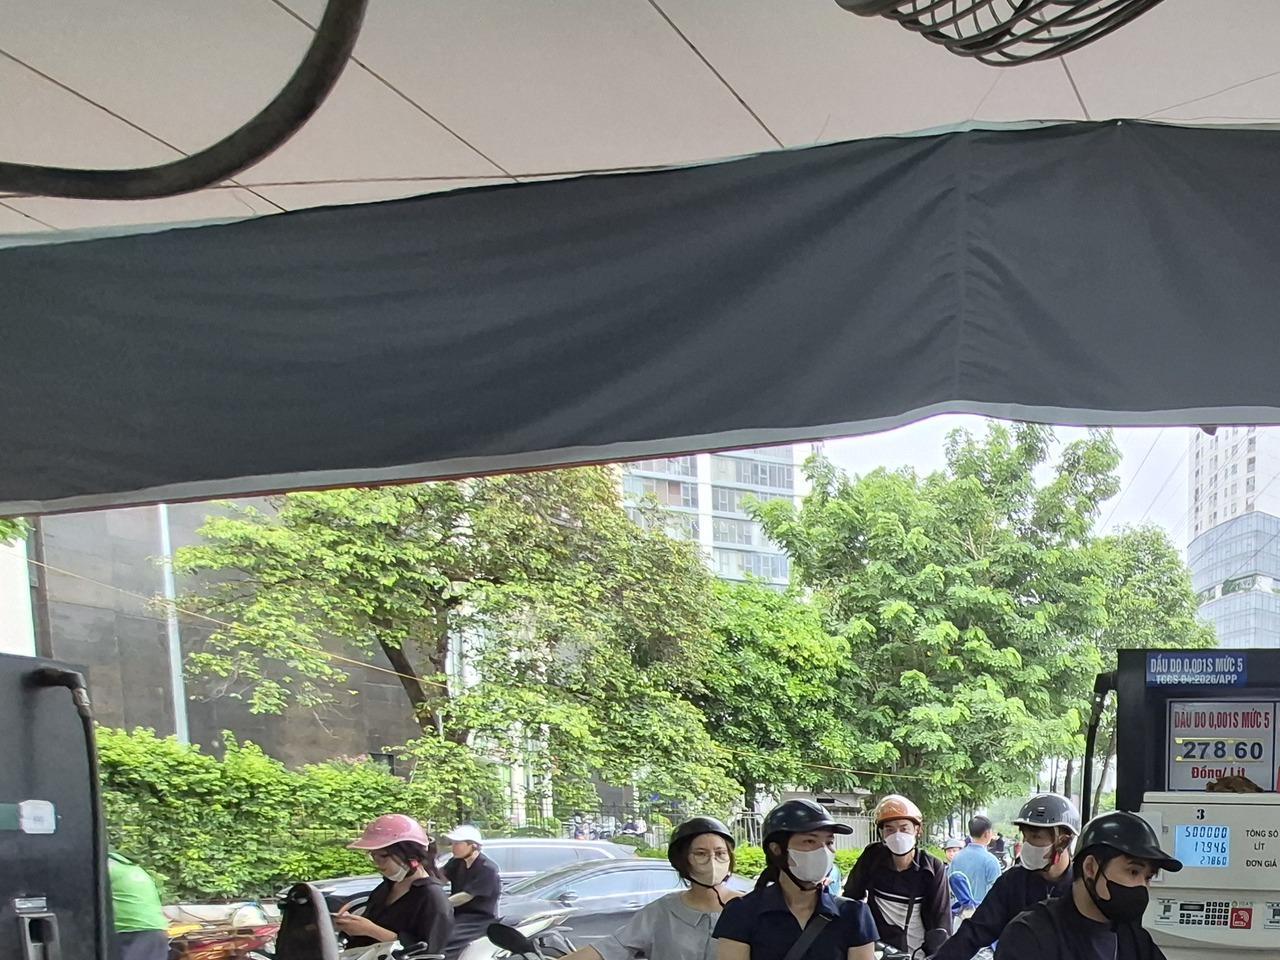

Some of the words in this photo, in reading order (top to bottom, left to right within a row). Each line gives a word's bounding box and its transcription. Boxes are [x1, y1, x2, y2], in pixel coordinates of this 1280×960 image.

[1170, 659, 1182, 673] DO
[1237, 658, 1243, 673] 5
[1194, 712, 1206, 728] DO
[1209, 712, 1239, 730] 0,001S
[1242, 708, 1261, 728] MỨC
[1264, 712, 1269, 728] 5
[1196, 809, 1205, 820] 3
[1185, 826, 1227, 838] 500000
